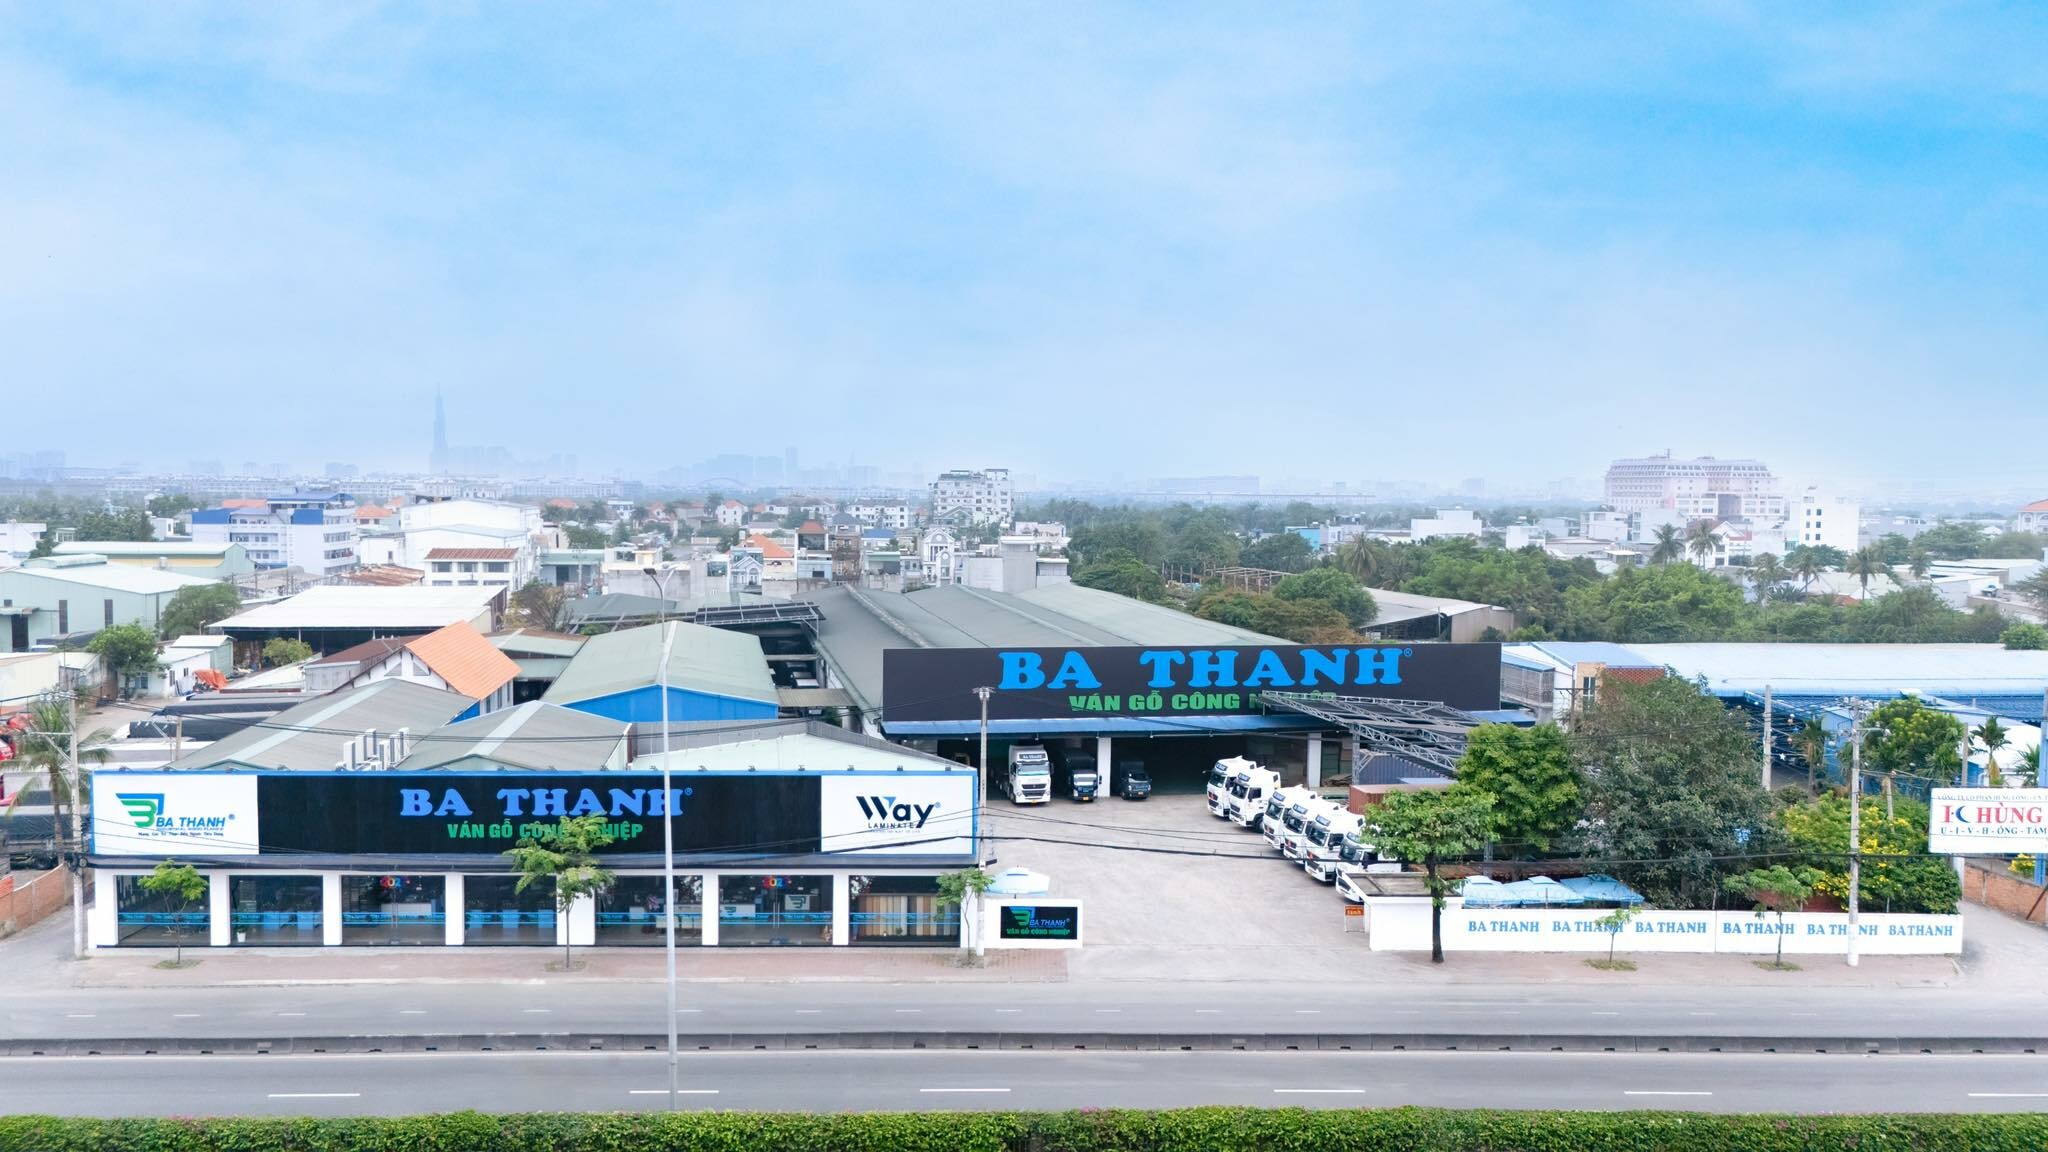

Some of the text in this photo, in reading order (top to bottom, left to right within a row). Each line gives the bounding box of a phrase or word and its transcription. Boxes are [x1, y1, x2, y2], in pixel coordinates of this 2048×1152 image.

[998, 649, 1403, 689] BA THANH
[1069, 693, 1121, 711] VÁN
[1129, 690, 1163, 711] GỖ
[1172, 691, 1240, 710] CÔNG
[400, 788, 473, 816] BA
[1976, 802, 2043, 824] HÙNG
[156, 816, 226, 828] BA THANH
[447, 820, 485, 839] VÁN
[489, 817, 513, 839] GỖ
[1468, 921, 1540, 932] BA THANH
[1553, 921, 1571, 932] BA
[1635, 922, 1707, 933] BA THANH
[1723, 923, 1795, 934] BA THANH
[1807, 924, 1878, 936] BA THNH
